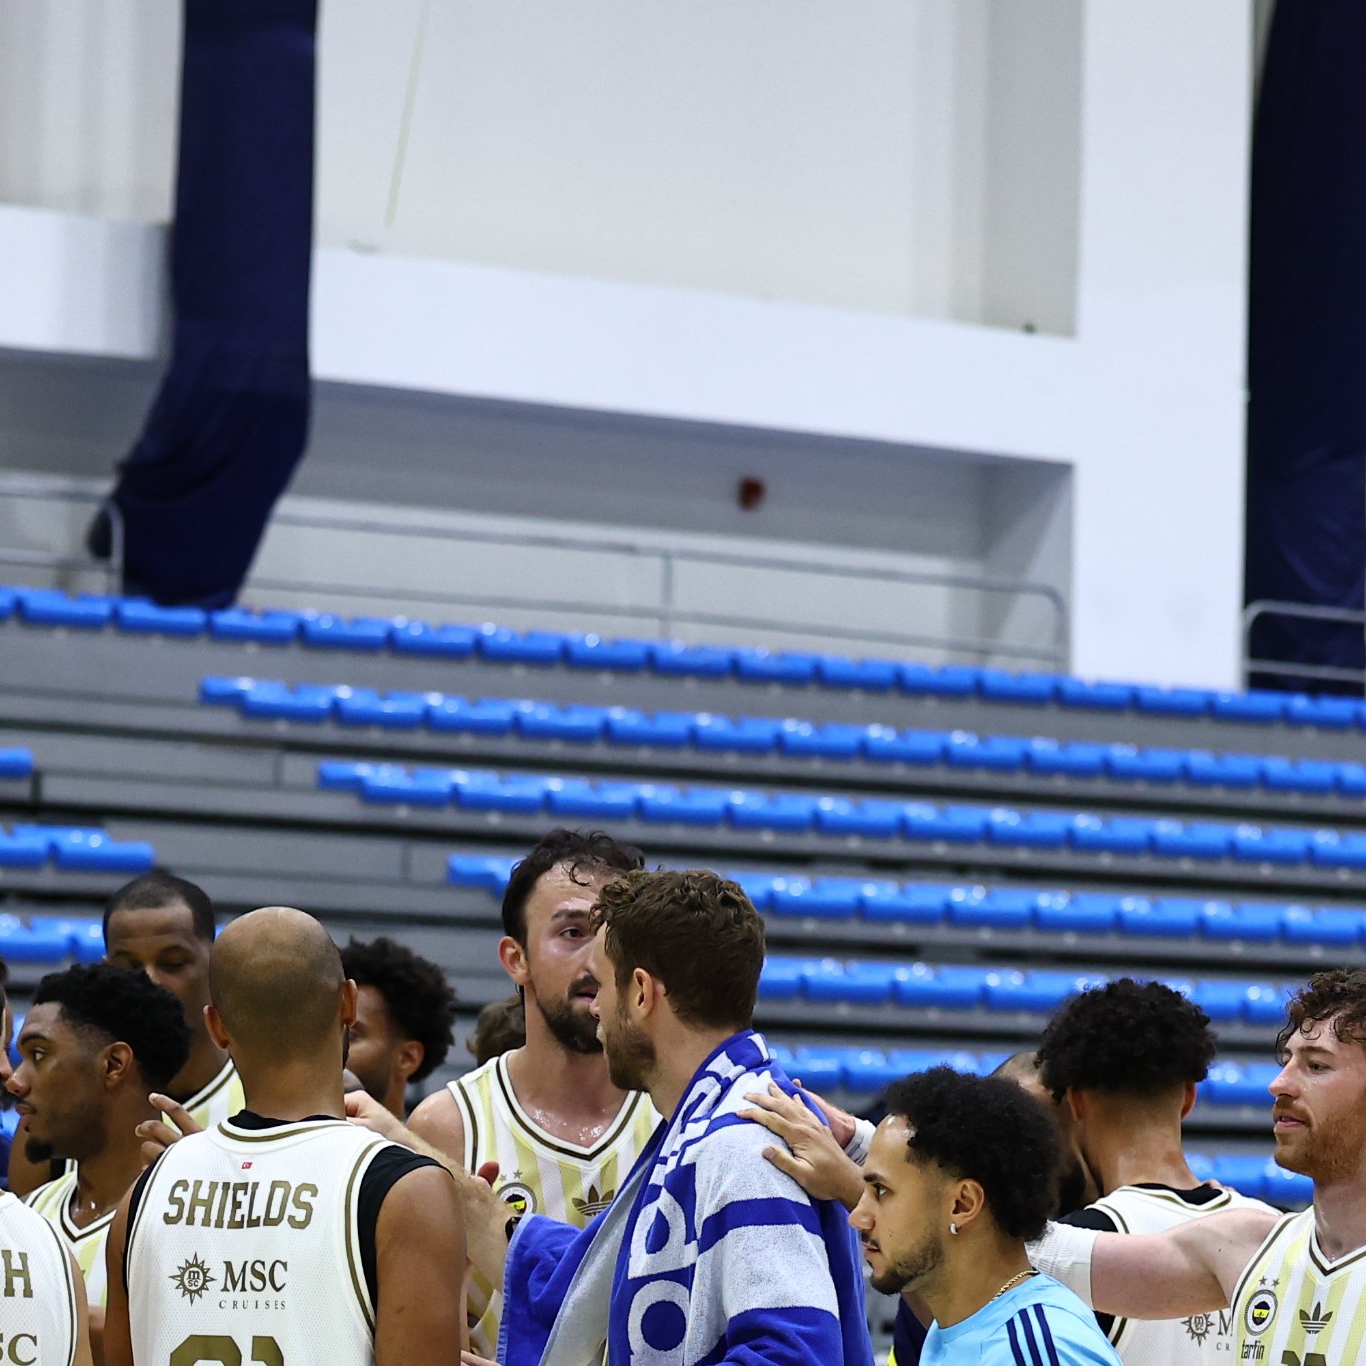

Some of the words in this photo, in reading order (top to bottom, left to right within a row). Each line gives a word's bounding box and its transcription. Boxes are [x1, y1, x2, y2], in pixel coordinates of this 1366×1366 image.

[162, 1179, 319, 1230] SHIELDS
[220, 1259, 288, 1293] MSC
[218, 1300, 286, 1310] CRUISES
[1241, 1339, 1265, 1360] tarfin
